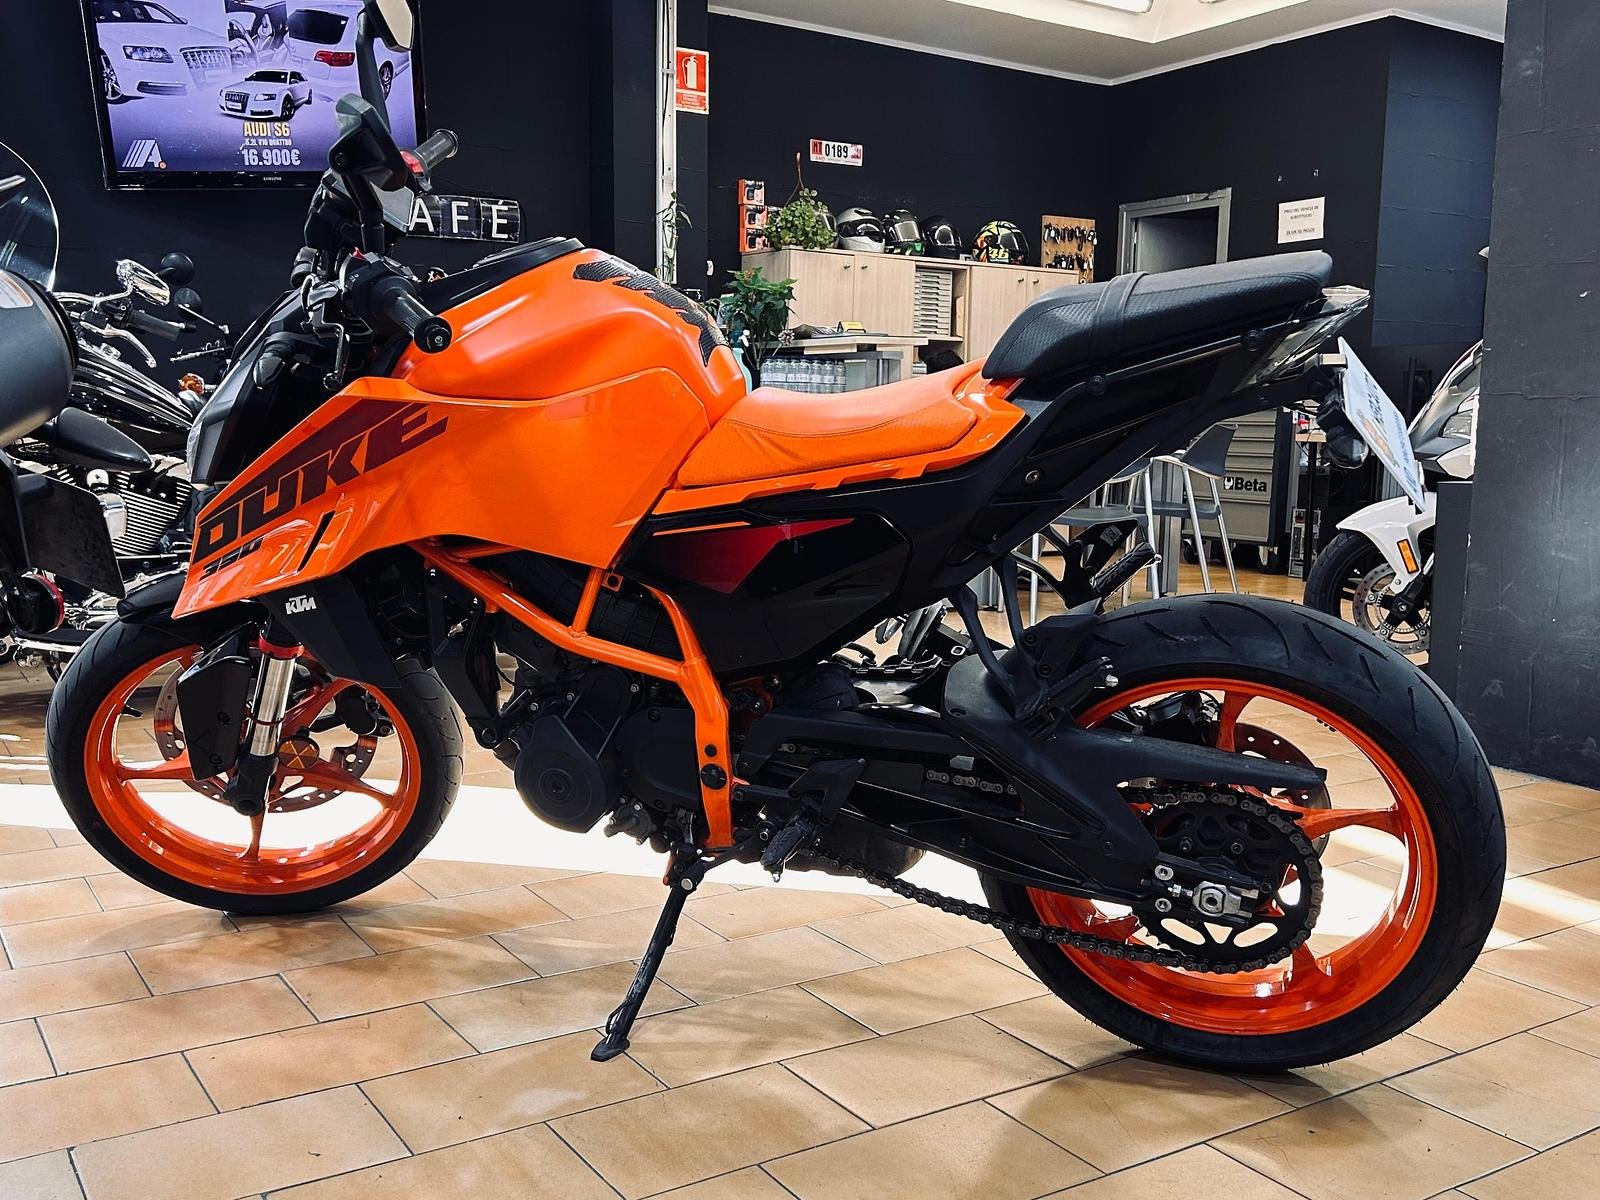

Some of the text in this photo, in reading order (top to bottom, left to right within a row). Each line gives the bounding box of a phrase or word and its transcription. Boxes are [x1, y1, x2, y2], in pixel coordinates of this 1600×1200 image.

[244, 121, 290, 137] AUDI S6
[241, 149, 301, 166] 16.900€
[825, 143, 848, 158] 0189
[989, 248, 1009, 259] 46
[191, 402, 449, 566] DUKE
[1234, 477, 1267, 492] Beta
[285, 594, 316, 614] KTM
